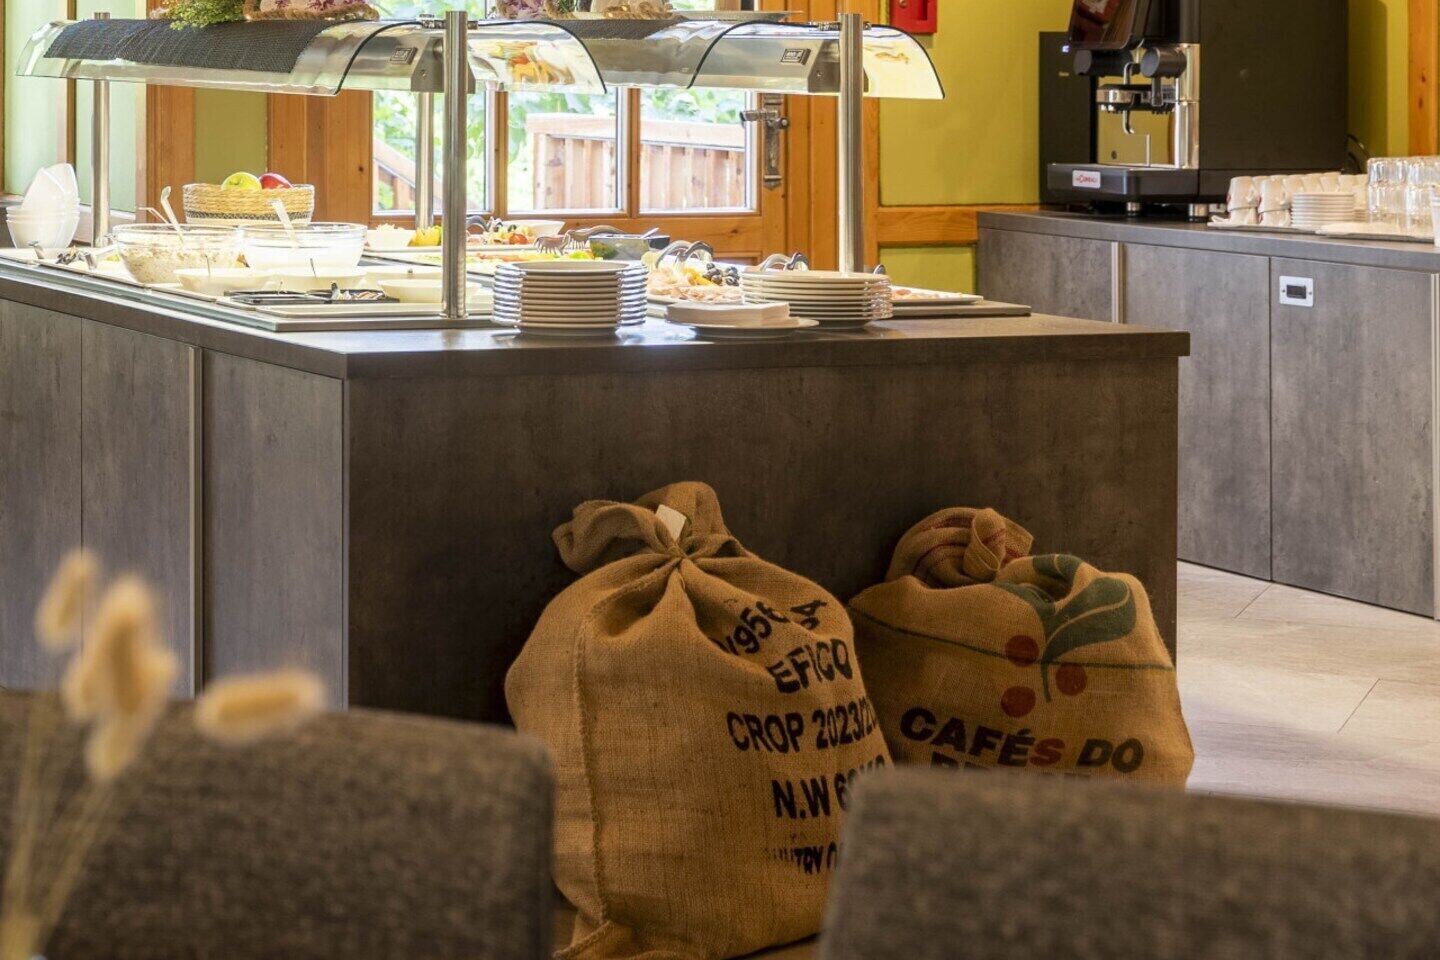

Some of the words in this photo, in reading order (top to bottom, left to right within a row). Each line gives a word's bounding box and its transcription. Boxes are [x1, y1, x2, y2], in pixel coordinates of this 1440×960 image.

[766, 638, 852, 693] EFICO
[726, 711, 804, 754] CROP
[900, 707, 1066, 768] CAFÉS
[1076, 738, 1144, 773] DO
